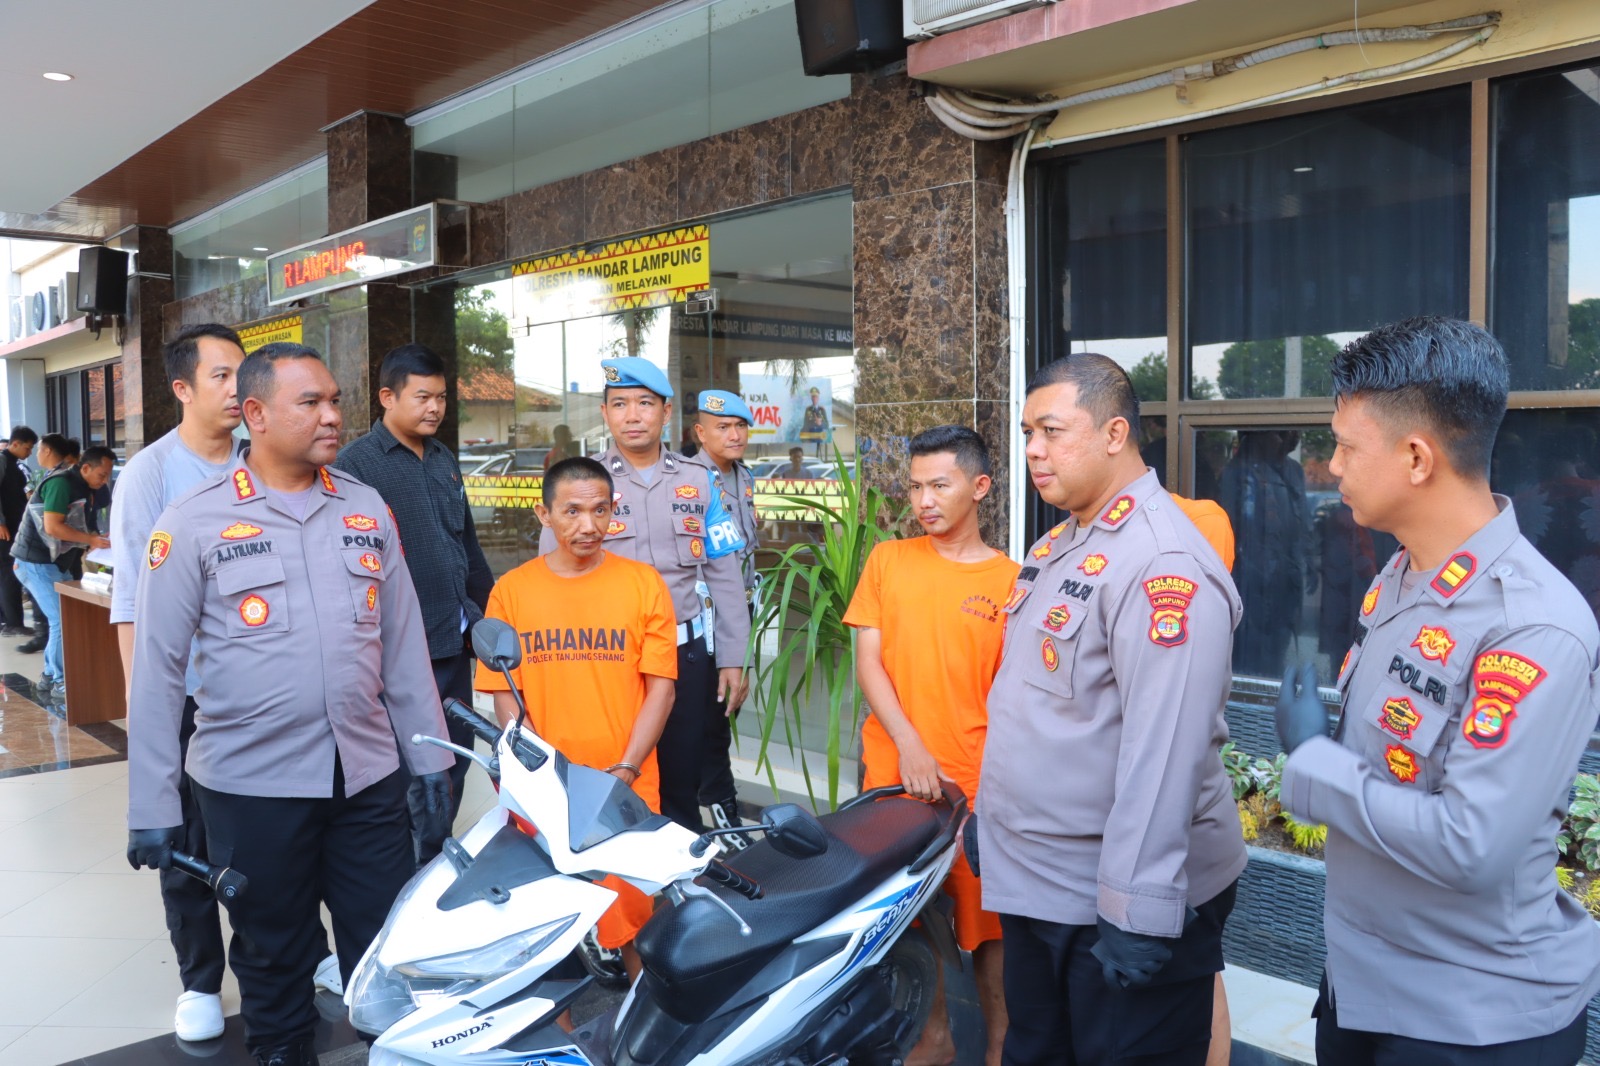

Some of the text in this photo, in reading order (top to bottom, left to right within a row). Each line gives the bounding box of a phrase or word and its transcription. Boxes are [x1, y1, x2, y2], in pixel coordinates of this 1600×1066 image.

[295, 241, 366, 285] LAMPUNG
[519, 269, 574, 294] OLRESTA
[577, 259, 629, 281] BANDAR
[632, 246, 702, 273] LAMPUNG
[616, 274, 672, 293] MELAYANI
[741, 322, 779, 337] LAMPUNG
[781, 327, 799, 338] DARI
[801, 328, 823, 340] MASA
[824, 328, 834, 341] KE
[672, 502, 704, 515] POLRI
[343, 535, 384, 551] POLRI
[707, 519, 741, 551] PR
[1057, 578, 1094, 602] POLRI
[1146, 577, 1193, 592] POLRESTA
[1153, 597, 1186, 606] LAMPUNG
[519, 627, 626, 655] TAHANAN
[527, 652, 625, 665] POLSEK TANJUNG SENANG
[1479, 653, 1539, 681] POLRESTA
[1388, 653, 1448, 706] POLRI
[1478, 679, 1521, 698] LAMPUNG
[431, 1021, 493, 1048] HONDA
